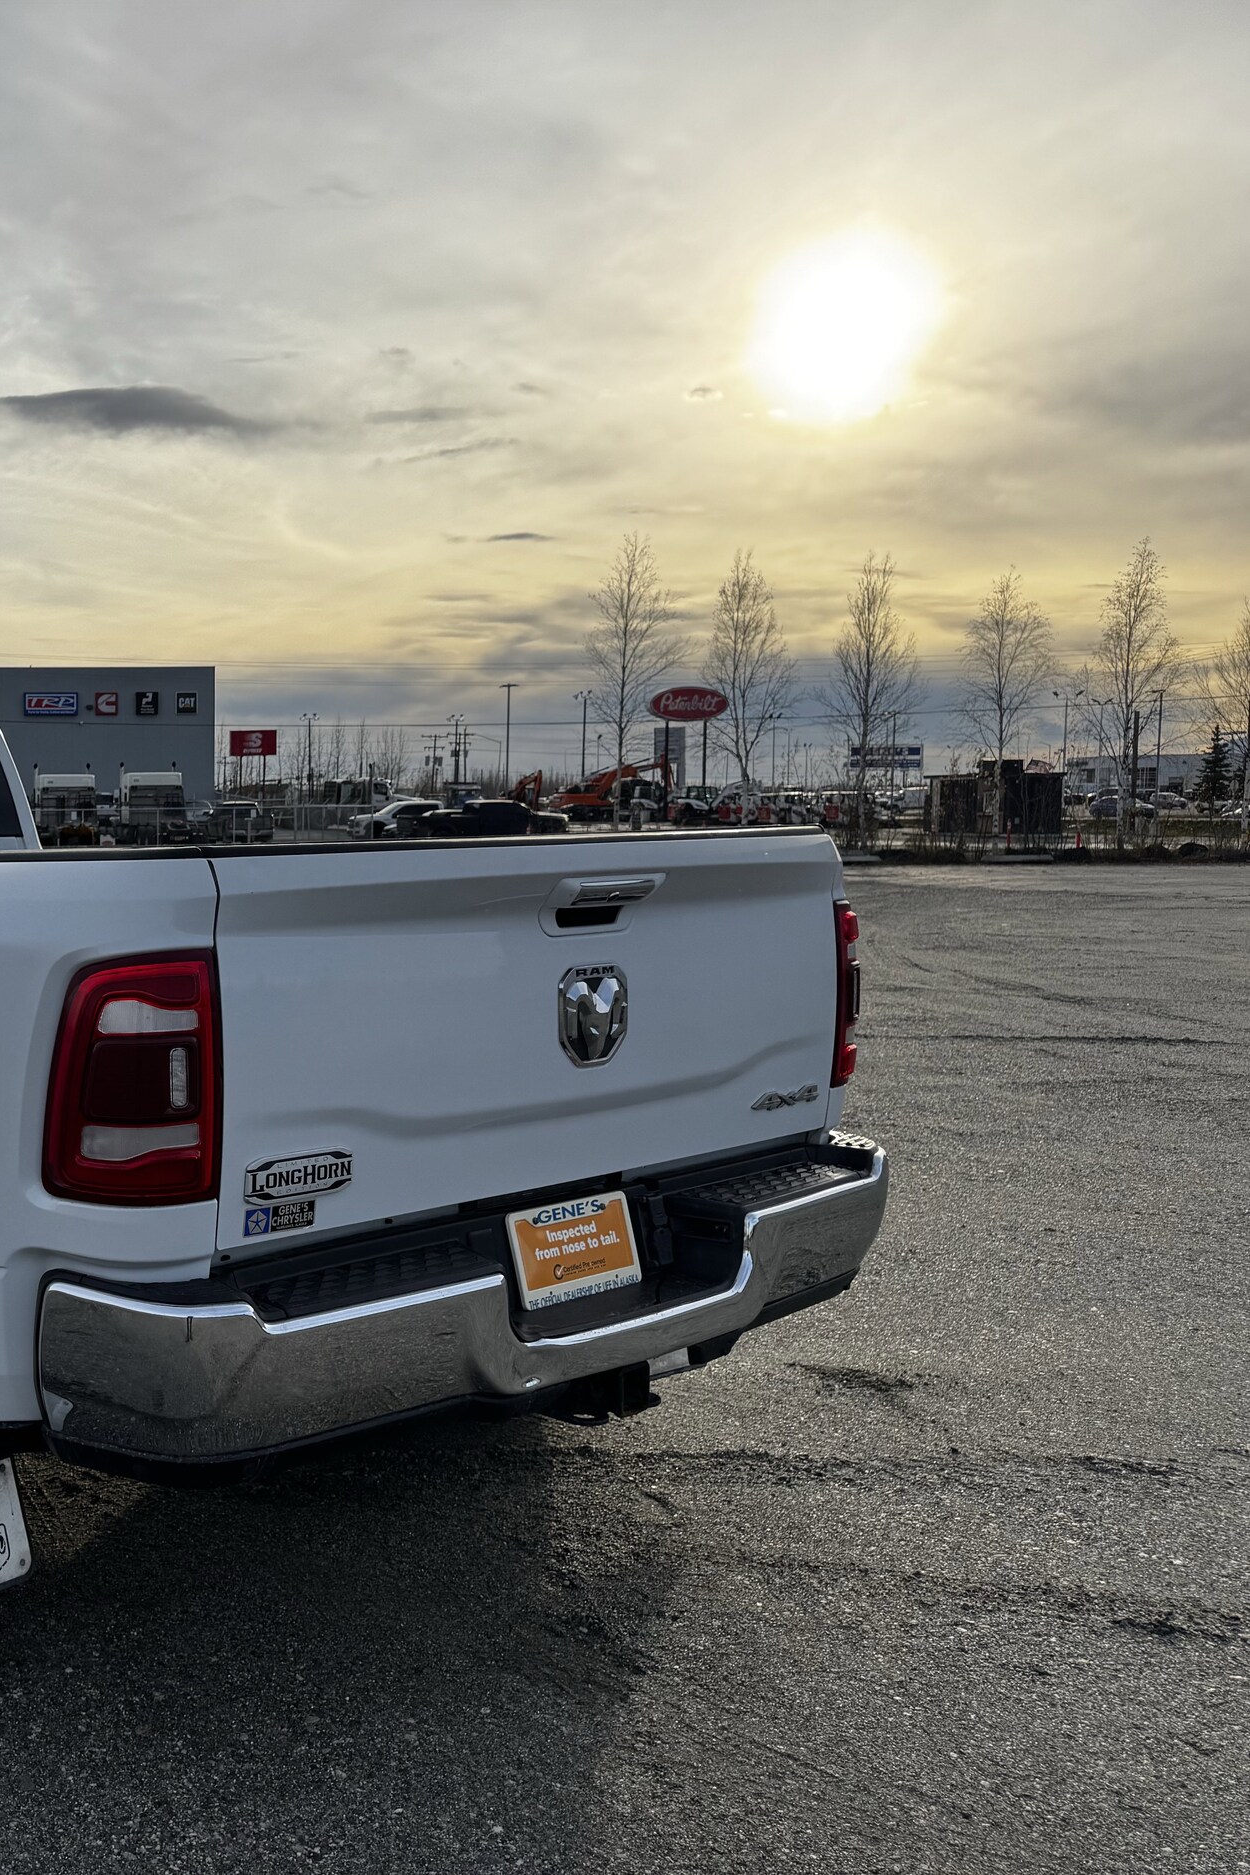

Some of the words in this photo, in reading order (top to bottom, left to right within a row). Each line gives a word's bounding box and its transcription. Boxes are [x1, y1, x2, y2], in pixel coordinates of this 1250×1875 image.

[28, 696, 74, 708] TRP
[178, 697, 196, 708] CAT
[659, 693, 722, 712] Peterbilt
[575, 966, 615, 977] RAM
[277, 1156, 329, 1169] LIMITED
[276, 1182, 328, 1195] EDITION
[278, 1202, 309, 1216] GENE'S
[537, 1199, 601, 1224] GENE'S
[271, 1211, 314, 1227] CHRYSLER
[546, 1220, 597, 1243] Inspected
[535, 1246, 561, 1261] from
[561, 1240, 586, 1255] nose
[587, 1236, 599, 1249] to
[600, 1230, 620, 1246] tail.
[529, 1299, 540, 1311] THE
[540, 1293, 563, 1307] OFFICIAL
[563, 1285, 594, 1302] DEALERSHIP
[594, 1283, 602, 1294] OF
[603, 1281, 613, 1292] LIFE
[619, 1273, 640, 1287] ALASKA
